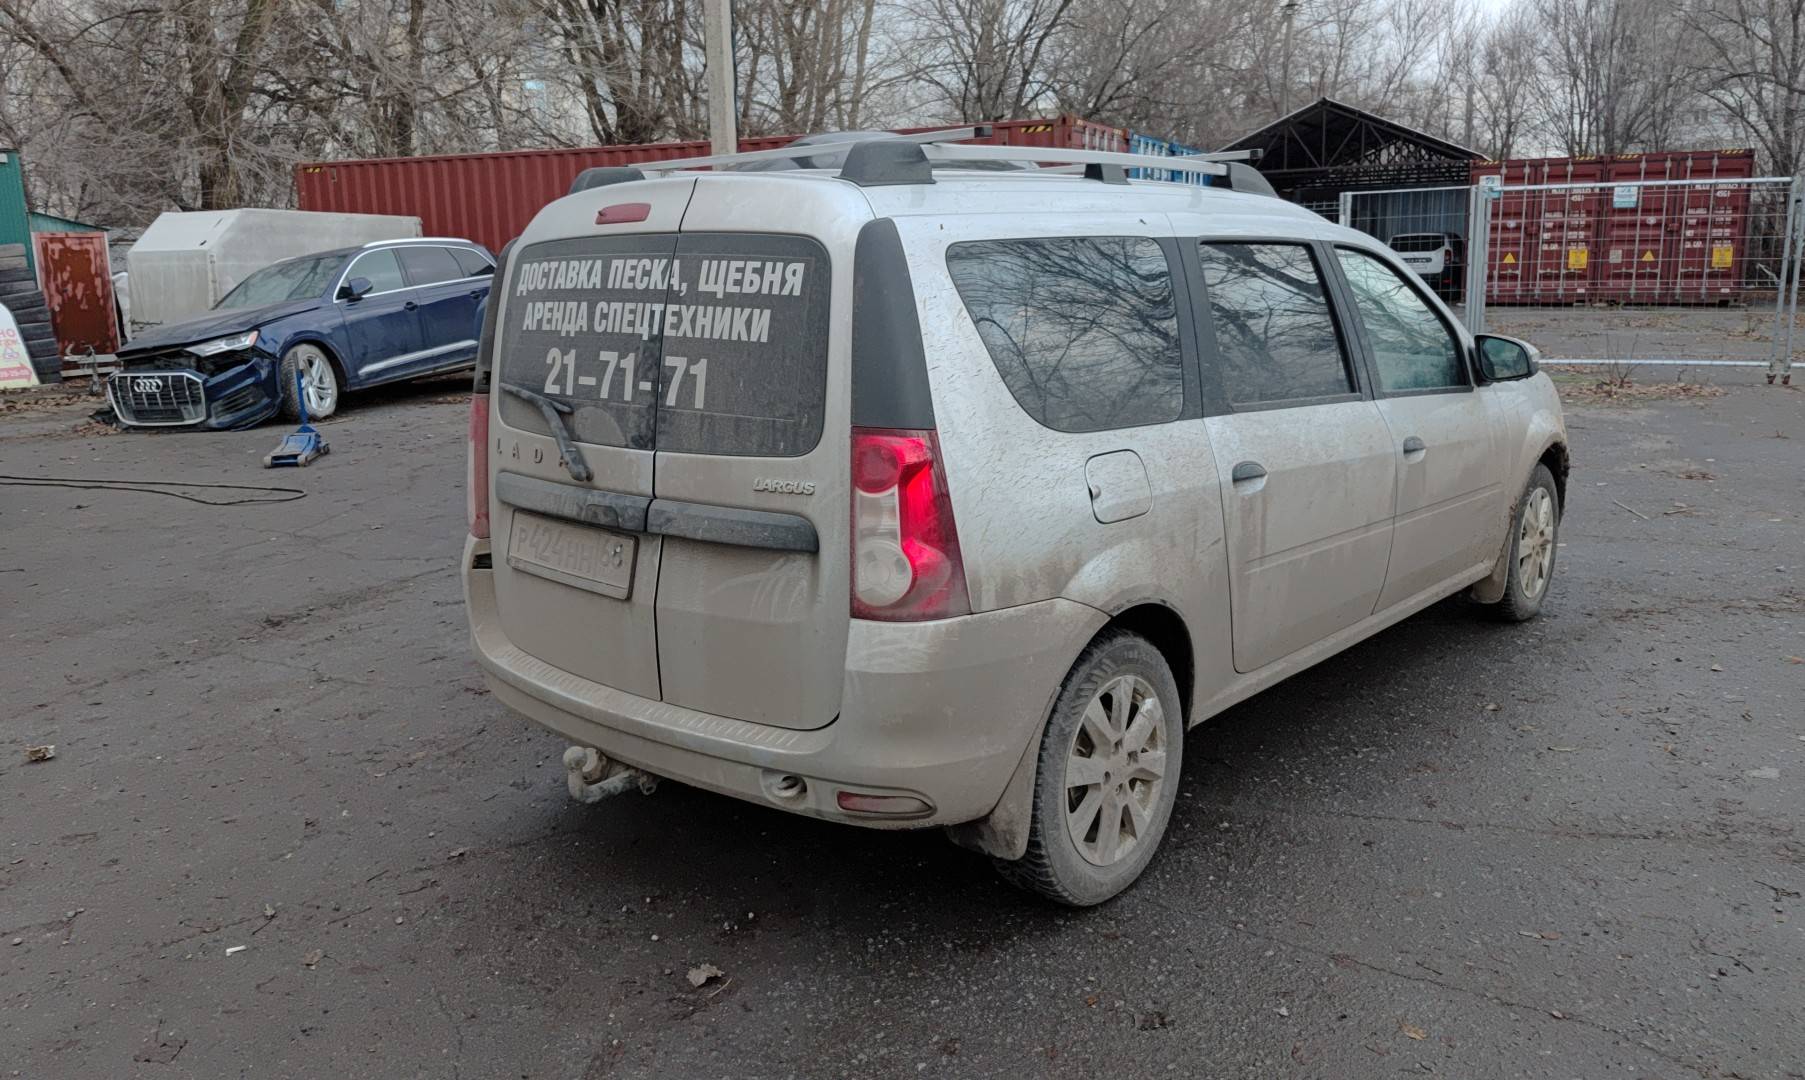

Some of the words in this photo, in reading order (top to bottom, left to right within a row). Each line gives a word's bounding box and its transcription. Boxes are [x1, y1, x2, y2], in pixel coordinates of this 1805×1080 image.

[516, 260, 602, 296] ДОСТАВКА
[607, 258, 688, 296] ПЕСКА,
[698, 259, 805, 299] ЩЕБНЯ
[523, 301, 588, 336] АРЕНДА
[594, 302, 771, 343] СПЕЦТЕХНИКИ
[753, 478, 817, 495] LARGUS
